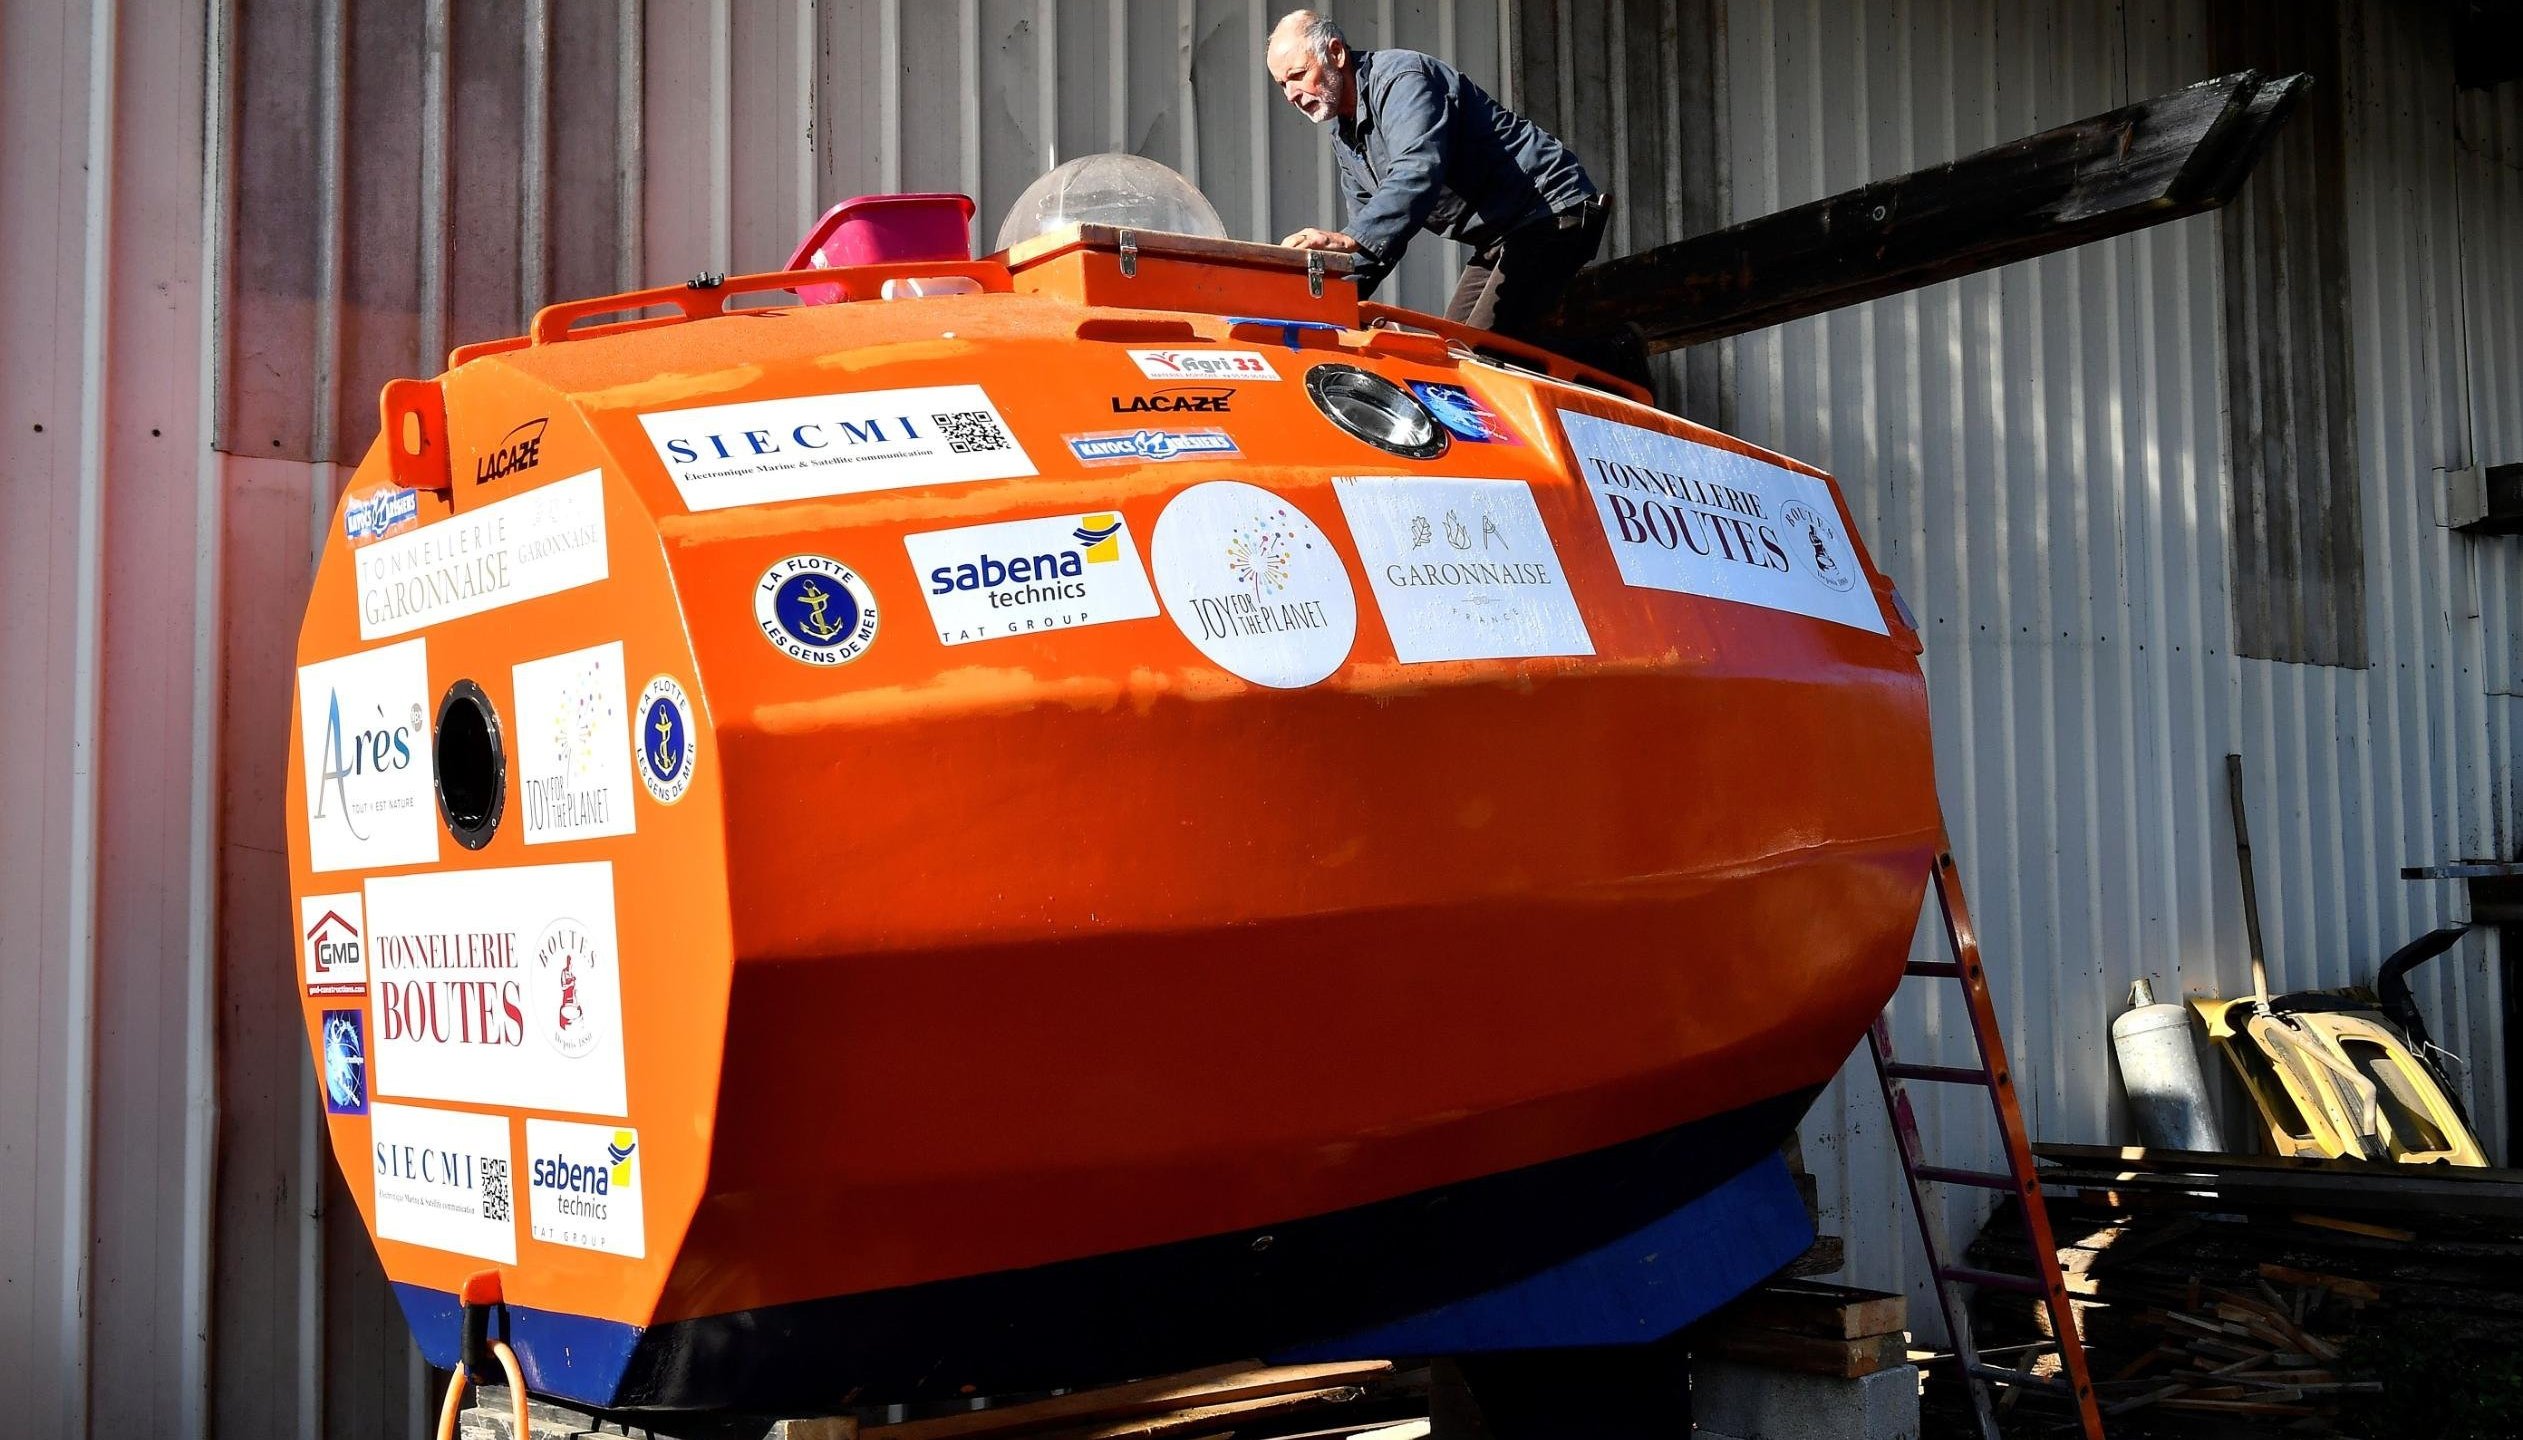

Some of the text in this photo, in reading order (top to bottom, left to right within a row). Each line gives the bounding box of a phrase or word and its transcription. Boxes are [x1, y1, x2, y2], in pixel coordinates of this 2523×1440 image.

[1181, 356, 1265, 373] Agri 33
[1111, 396, 1232, 413] LACAZE
[666, 415, 925, 465] SIECMI
[476, 438, 541, 486] LACAZE
[684, 448, 934, 482] Électronique Marine & Satellite communication
[1589, 457, 1769, 519] TONNELLERIE
[1605, 493, 1790, 573] BOUTES
[1785, 506, 1834, 540] BOUTES
[361, 516, 507, 581] TONNELLERIE
[518, 524, 599, 565] GARONNAISE
[365, 549, 511, 627] GARONNAISE
[761, 558, 854, 591] LA FLOTTE
[931, 550, 1083, 595] sabena
[1386, 562, 1552, 587] GARONNAISE
[988, 581, 1086, 610] technics
[1231, 593, 1256, 615] FOR
[762, 608, 876, 663] LES GENS DE MER
[943, 613, 1090, 643] TAT GROUP
[1188, 597, 1239, 641] JOY
[1239, 614, 1264, 636] THE
[1261, 600, 1328, 635] PLANET
[640, 680, 687, 715] LA FLOTTE
[313, 685, 412, 841] Arès
[636, 742, 695, 801] LES GENS DE MER
[388, 796, 414, 809] NATURE
[526, 779, 552, 832] JOY
[551, 775, 565, 804] FOR
[566, 787, 611, 827] PLANET
[552, 803, 568, 829] THE
[320, 942, 360, 966] GMD
[376, 931, 519, 971] TONNELLERIE
[538, 928, 598, 970] BOUTES
[380, 979, 524, 1048] BOUTES
[376, 1141, 474, 1190] SIECMI
[533, 1154, 609, 1196] sabena
[557, 1196, 608, 1221] technics
[533, 1225, 606, 1249] TAT GROUP
